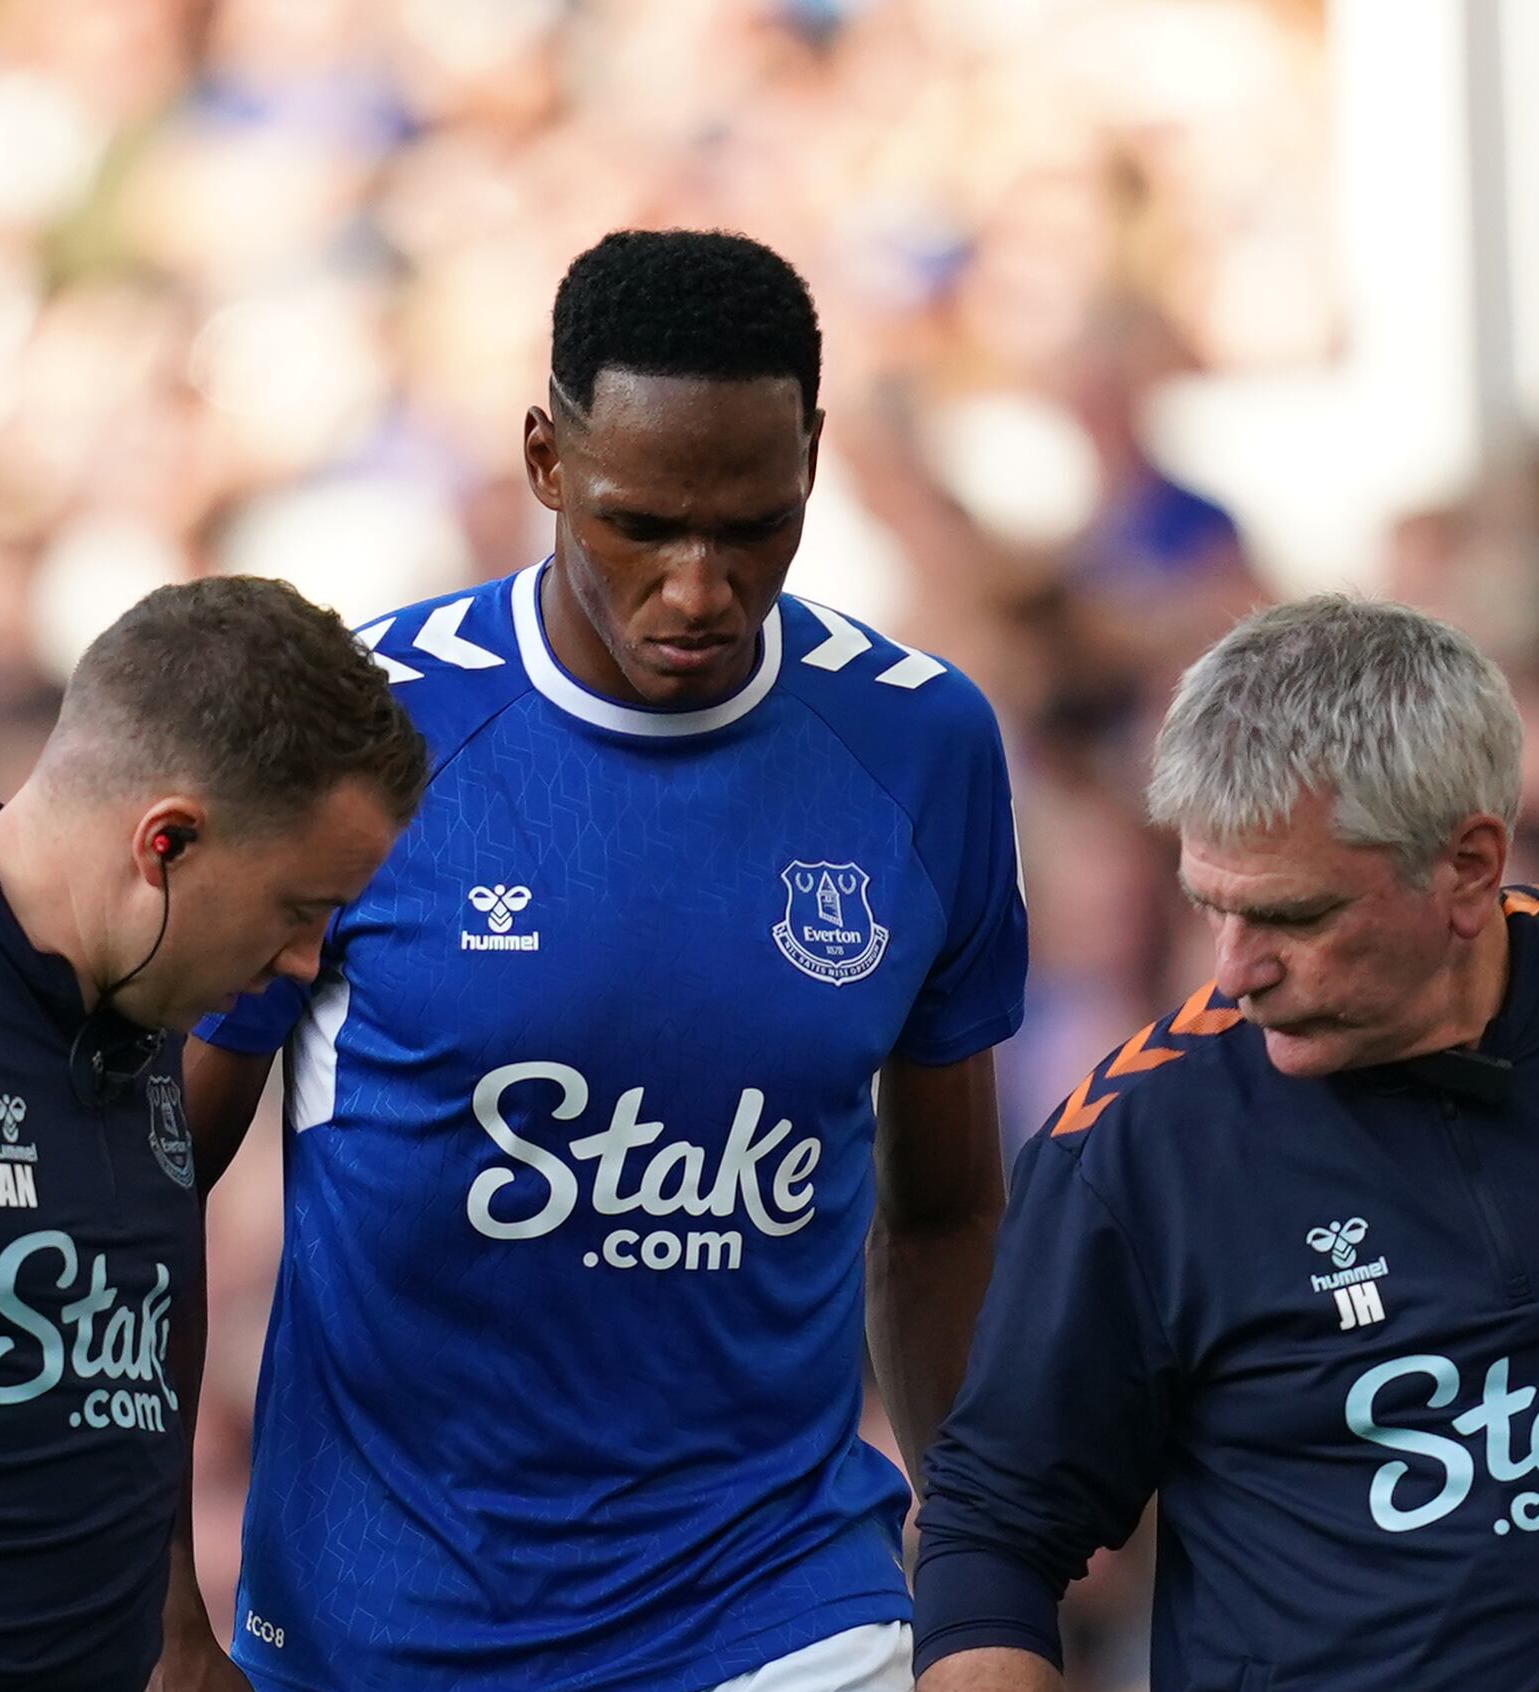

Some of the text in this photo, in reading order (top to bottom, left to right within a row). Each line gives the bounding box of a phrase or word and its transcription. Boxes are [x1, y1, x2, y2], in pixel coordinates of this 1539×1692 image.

[462, 931, 540, 952] hummel
[803, 926, 862, 944] Everton
[826, 946, 845, 956] 1878
[784, 941, 797, 957] NIL
[798, 956, 826, 975] SATIS
[467, 1060, 822, 1240] Stake
[582, 1228, 743, 1271] .com
[1310, 1256, 1390, 1293] hummel
[1333, 1281, 1386, 1331] JH
[68, 1388, 166, 1433] .com
